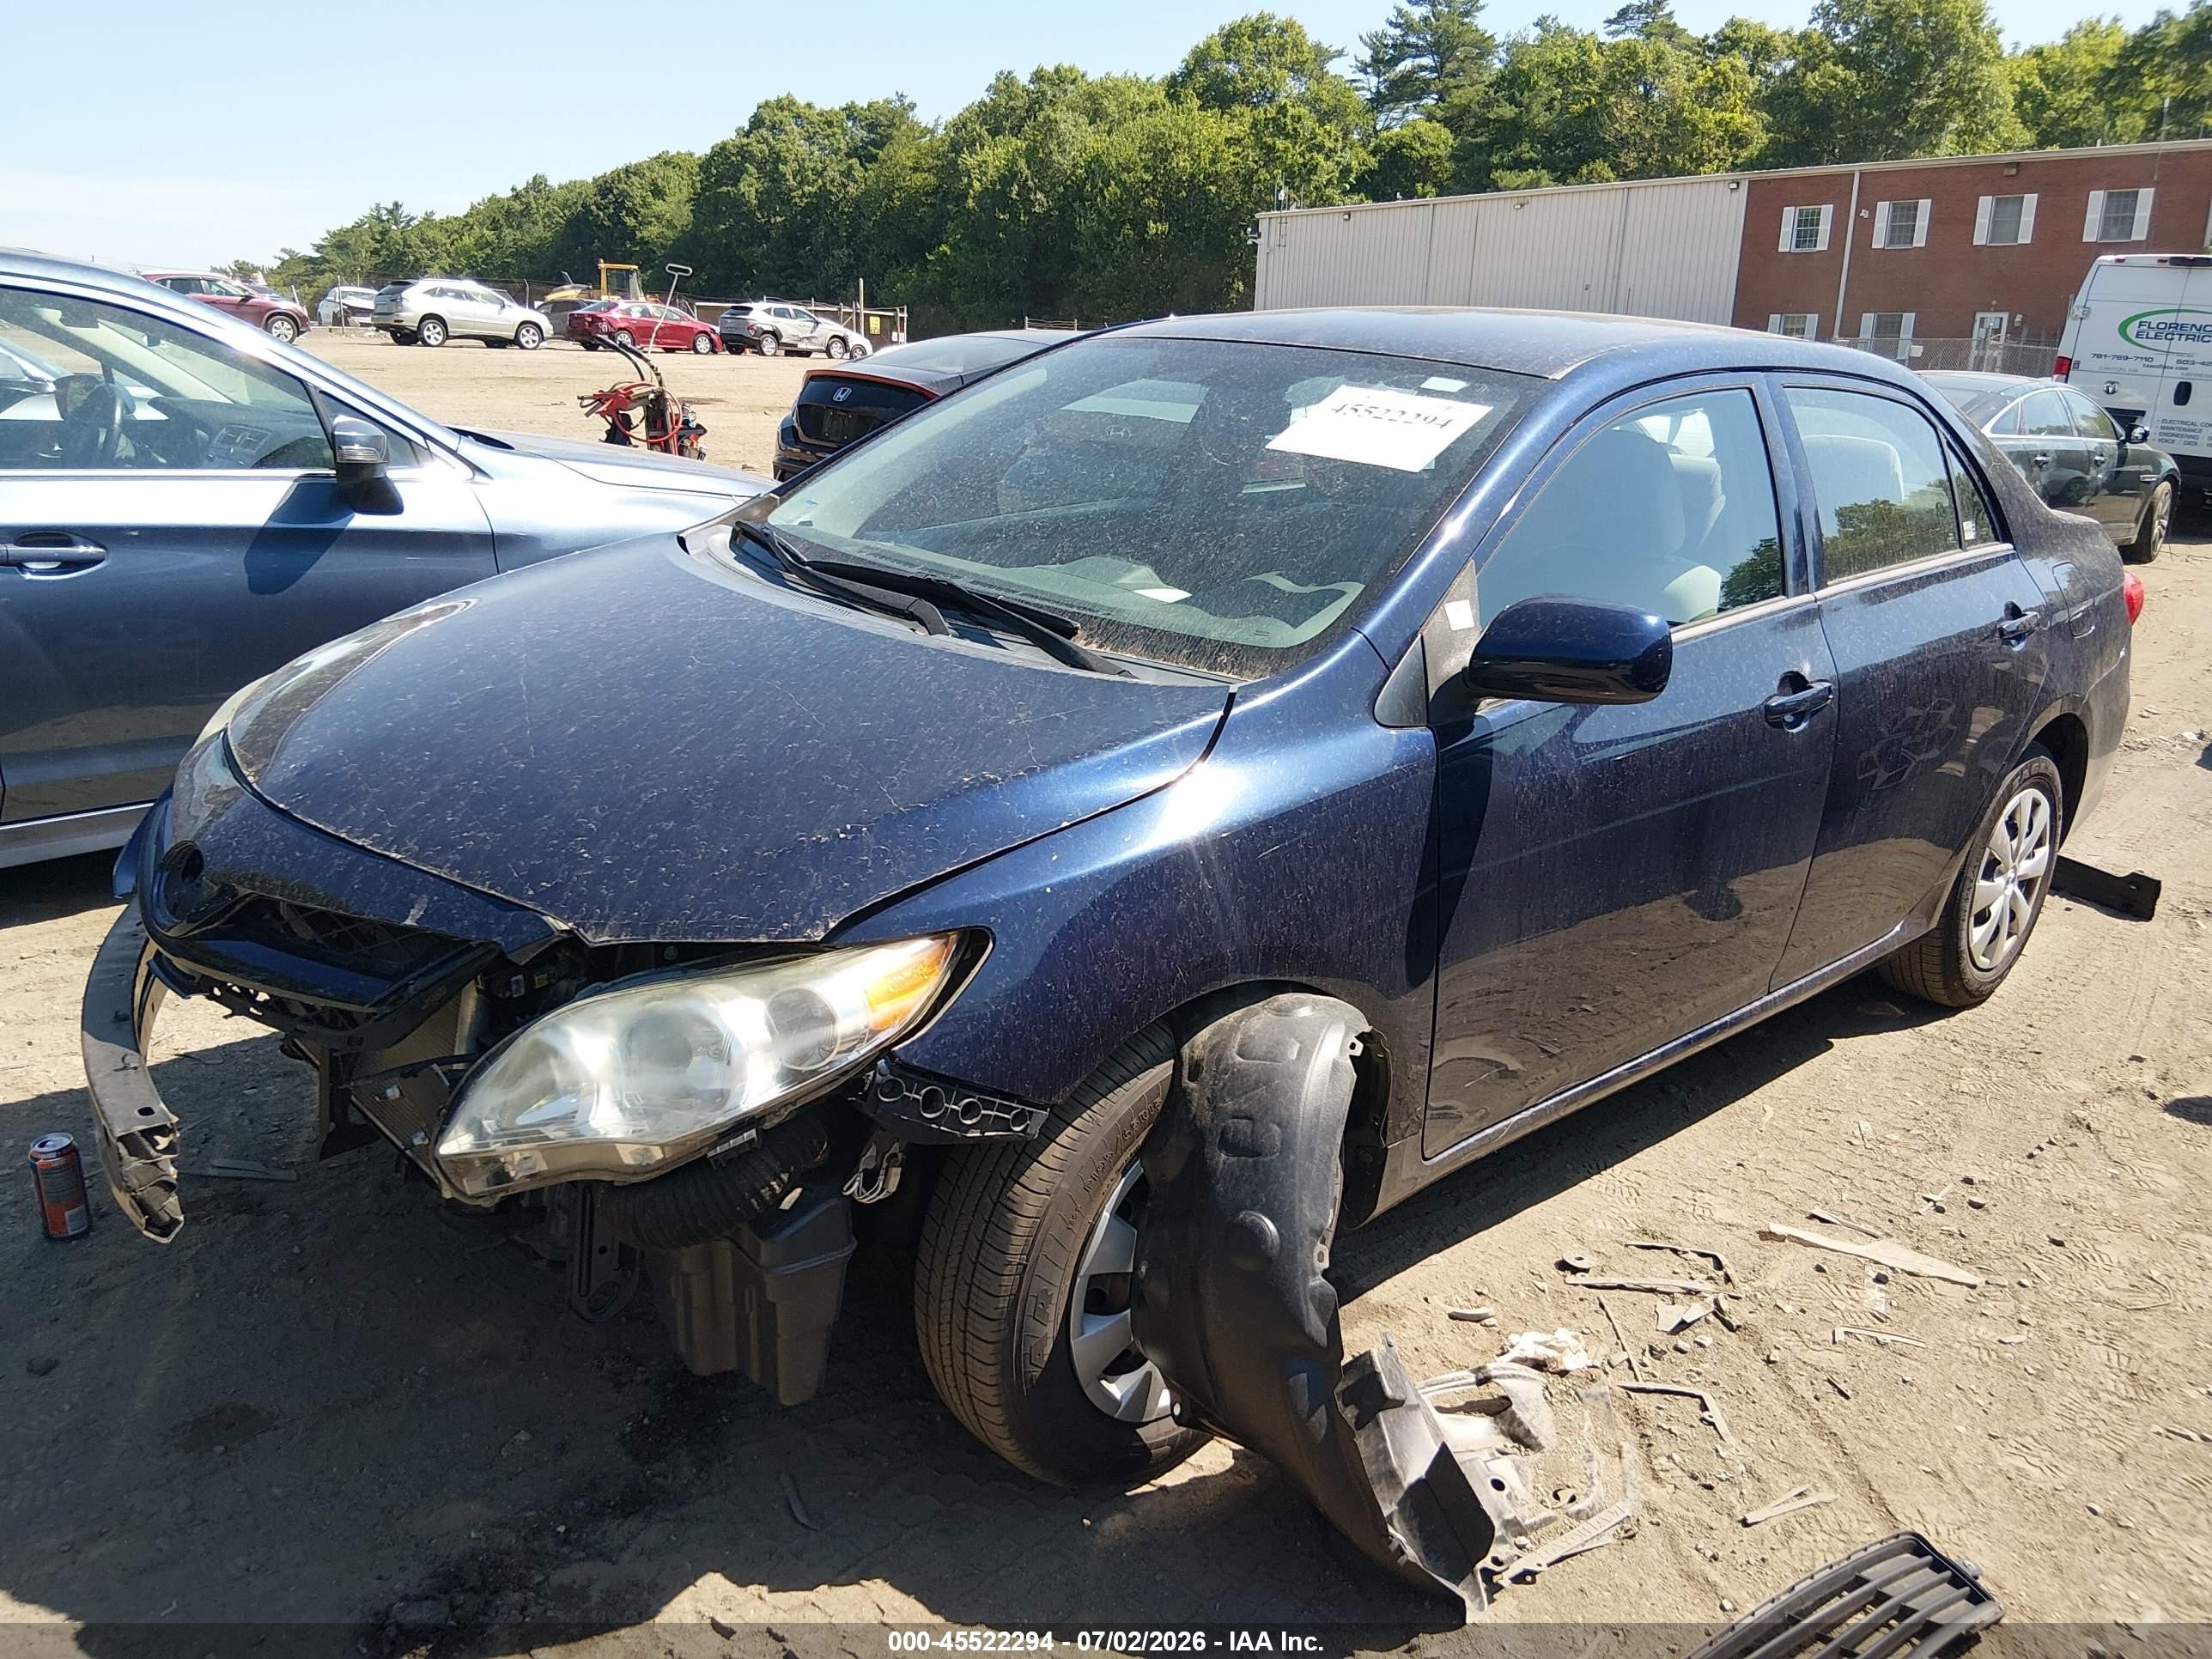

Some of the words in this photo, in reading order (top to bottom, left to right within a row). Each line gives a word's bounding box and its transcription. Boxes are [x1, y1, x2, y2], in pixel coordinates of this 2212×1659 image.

[2135, 331, 2212, 343] ELECTRIC
[2161, 418, 2198, 427] ELECTRICAL
[2160, 425, 2203, 434] MAINTENANCE
